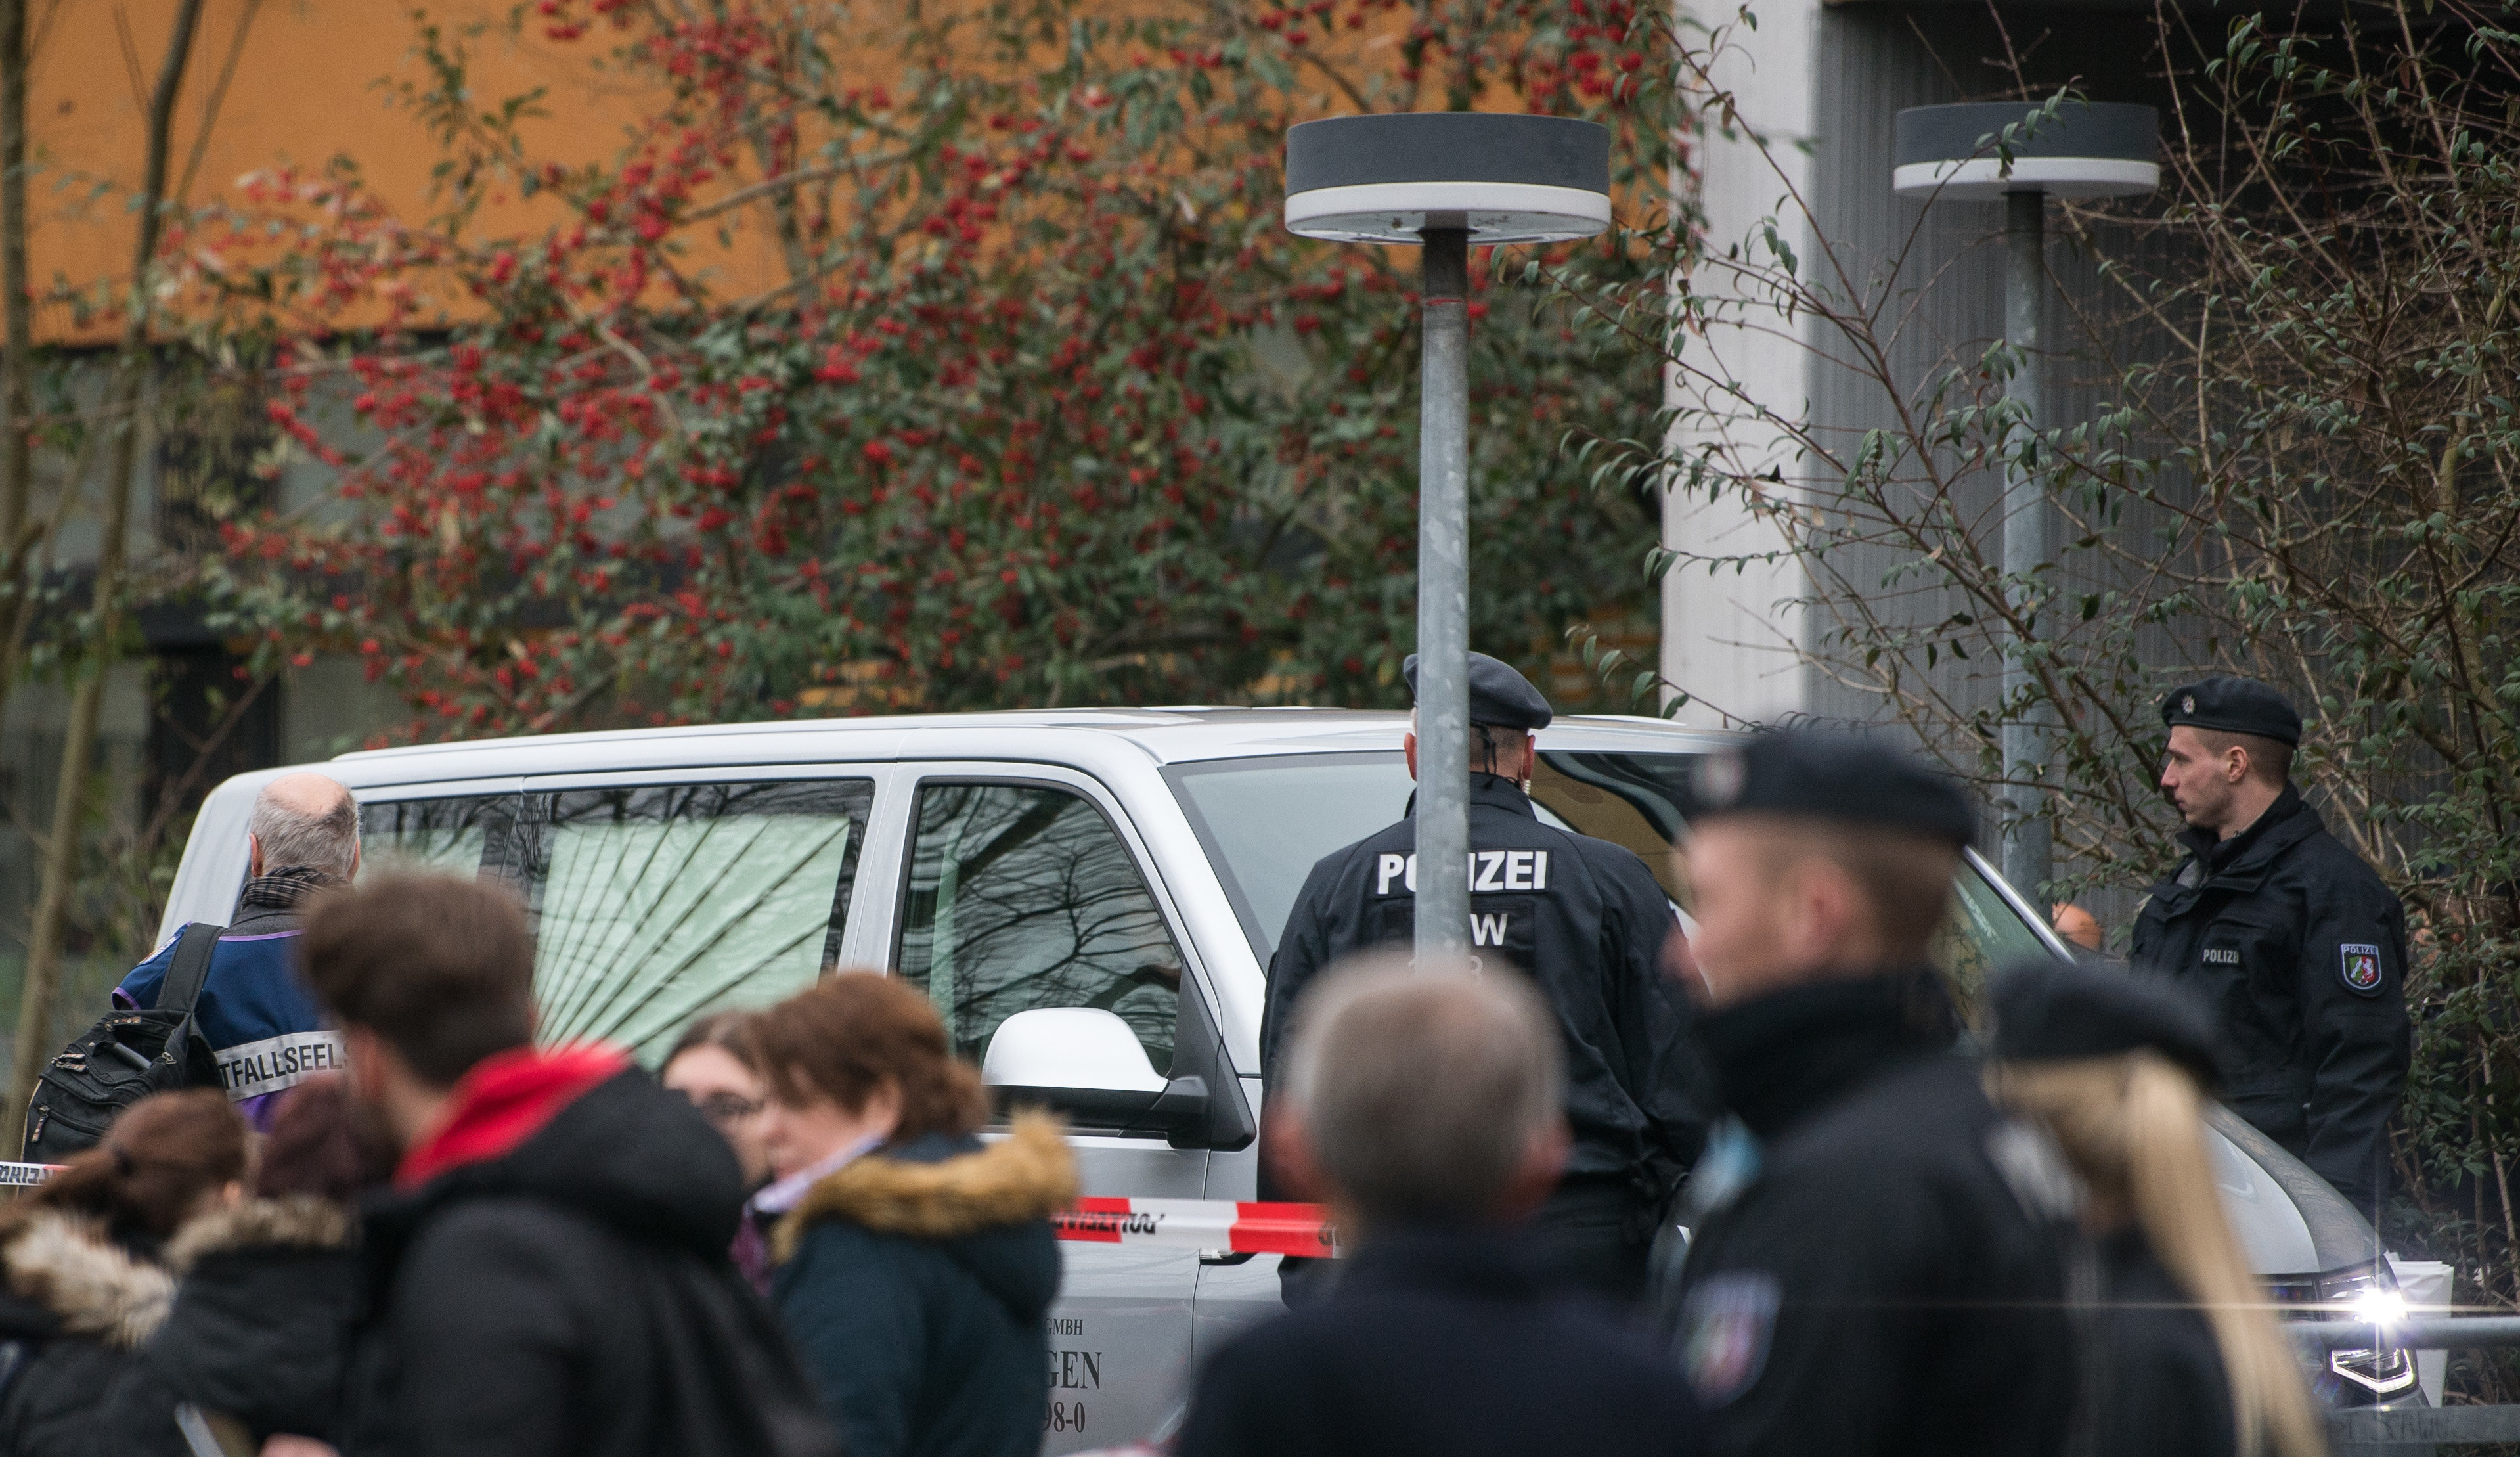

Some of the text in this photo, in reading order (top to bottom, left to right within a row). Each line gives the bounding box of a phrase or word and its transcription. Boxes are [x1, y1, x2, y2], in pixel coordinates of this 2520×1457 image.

[1377, 851, 1547, 895] PIZEI
[219, 1043, 345, 1090] TFALLSEEL
[1045, 1350, 1103, 1390] GEN
[1042, 1401, 1086, 1433] 98-0
